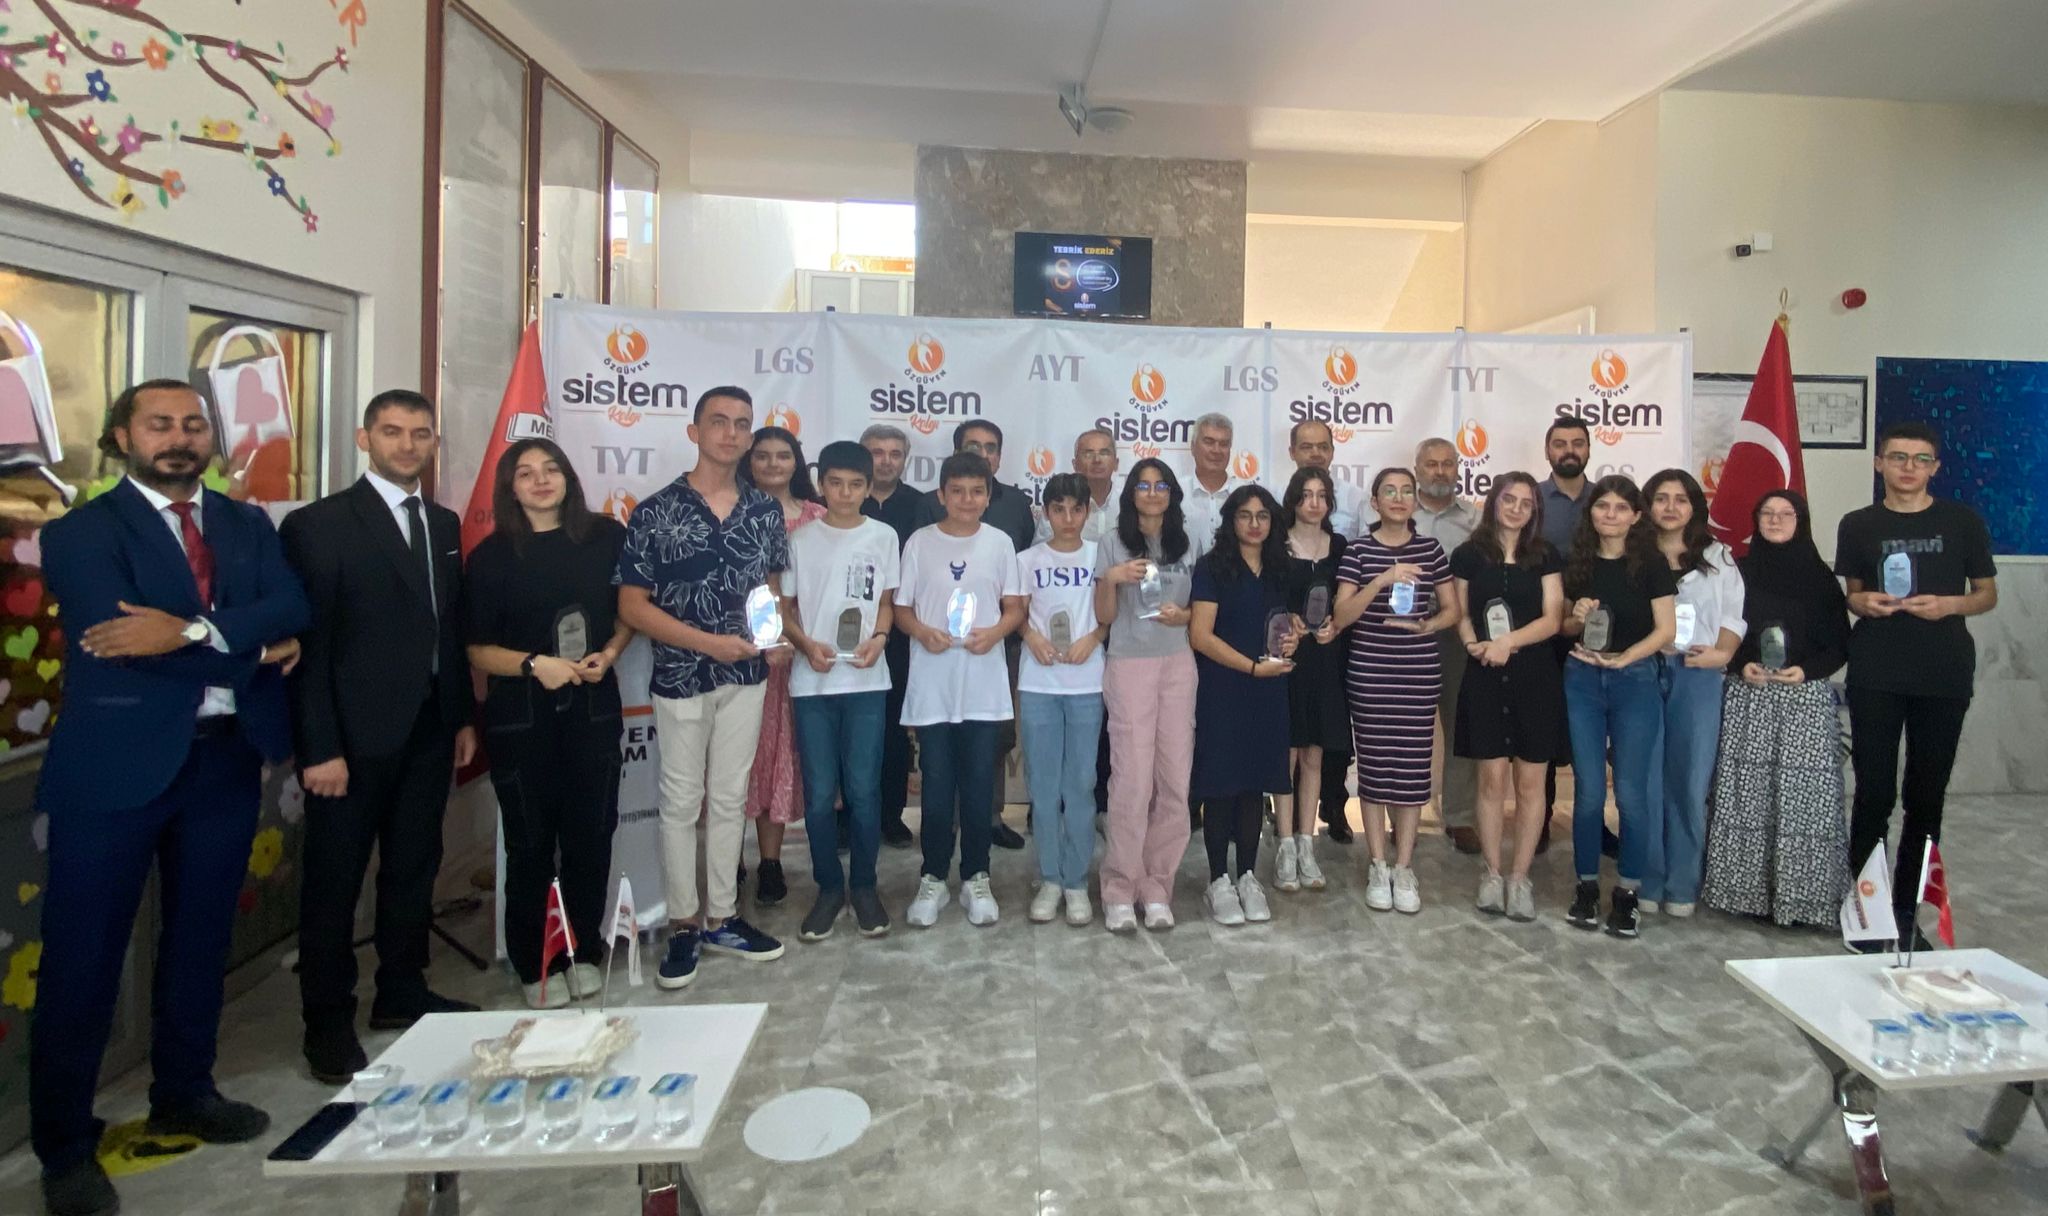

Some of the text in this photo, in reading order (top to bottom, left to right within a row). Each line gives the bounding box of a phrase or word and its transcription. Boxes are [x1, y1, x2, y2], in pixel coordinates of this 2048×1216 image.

[603, 357, 650, 375] ÖZGÜVEN
[754, 347, 815, 374] LGS
[1028, 354, 1085, 382] AYT
[904, 368, 947, 384] ÖZGÜVEN
[1223, 366, 1279, 392] LGS
[1322, 380, 1361, 395] ÖZGÜVEN
[1446, 367, 1500, 392] TYT
[562, 373, 688, 408] sistem
[870, 383, 981, 415] sistem
[1589, 384, 1630, 398] ÖZGÜVEN
[1129, 397, 1169, 413] ÖZGÜVEN
[1289, 395, 1393, 424] sistem
[1555, 397, 1662, 427] sistem
[591, 446, 656, 475] TYT
